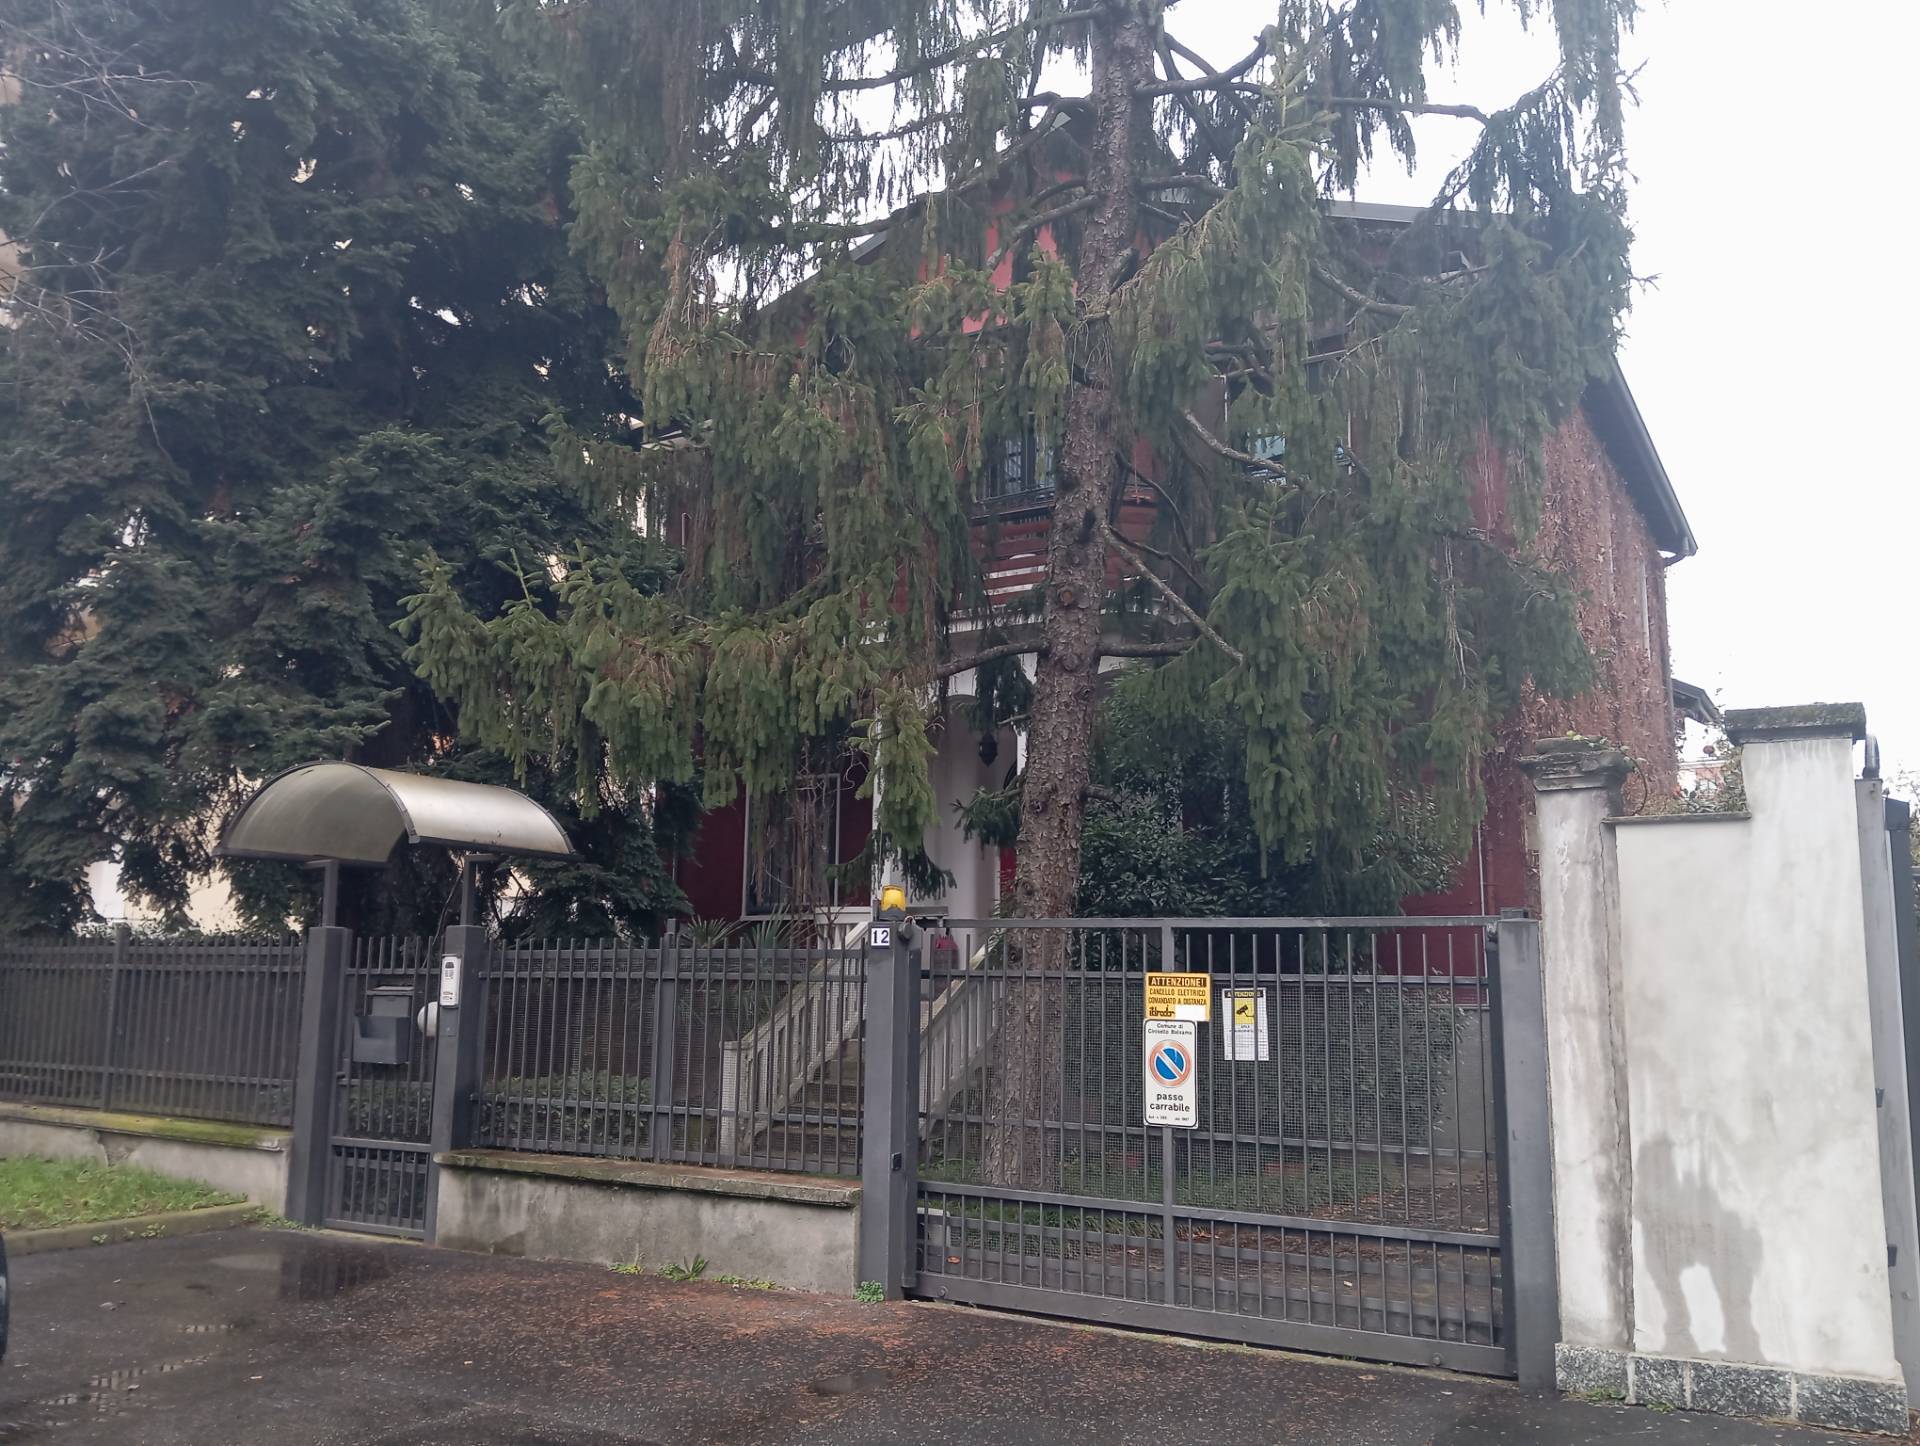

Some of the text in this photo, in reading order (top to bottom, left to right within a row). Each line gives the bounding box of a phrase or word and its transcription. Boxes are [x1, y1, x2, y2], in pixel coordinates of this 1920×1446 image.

[873, 930, 888, 943] 12
[1151, 977, 1204, 986] ATTENZIONE!
[1157, 1094, 1184, 1102] passo
[1150, 1103, 1190, 1112] carrabile
